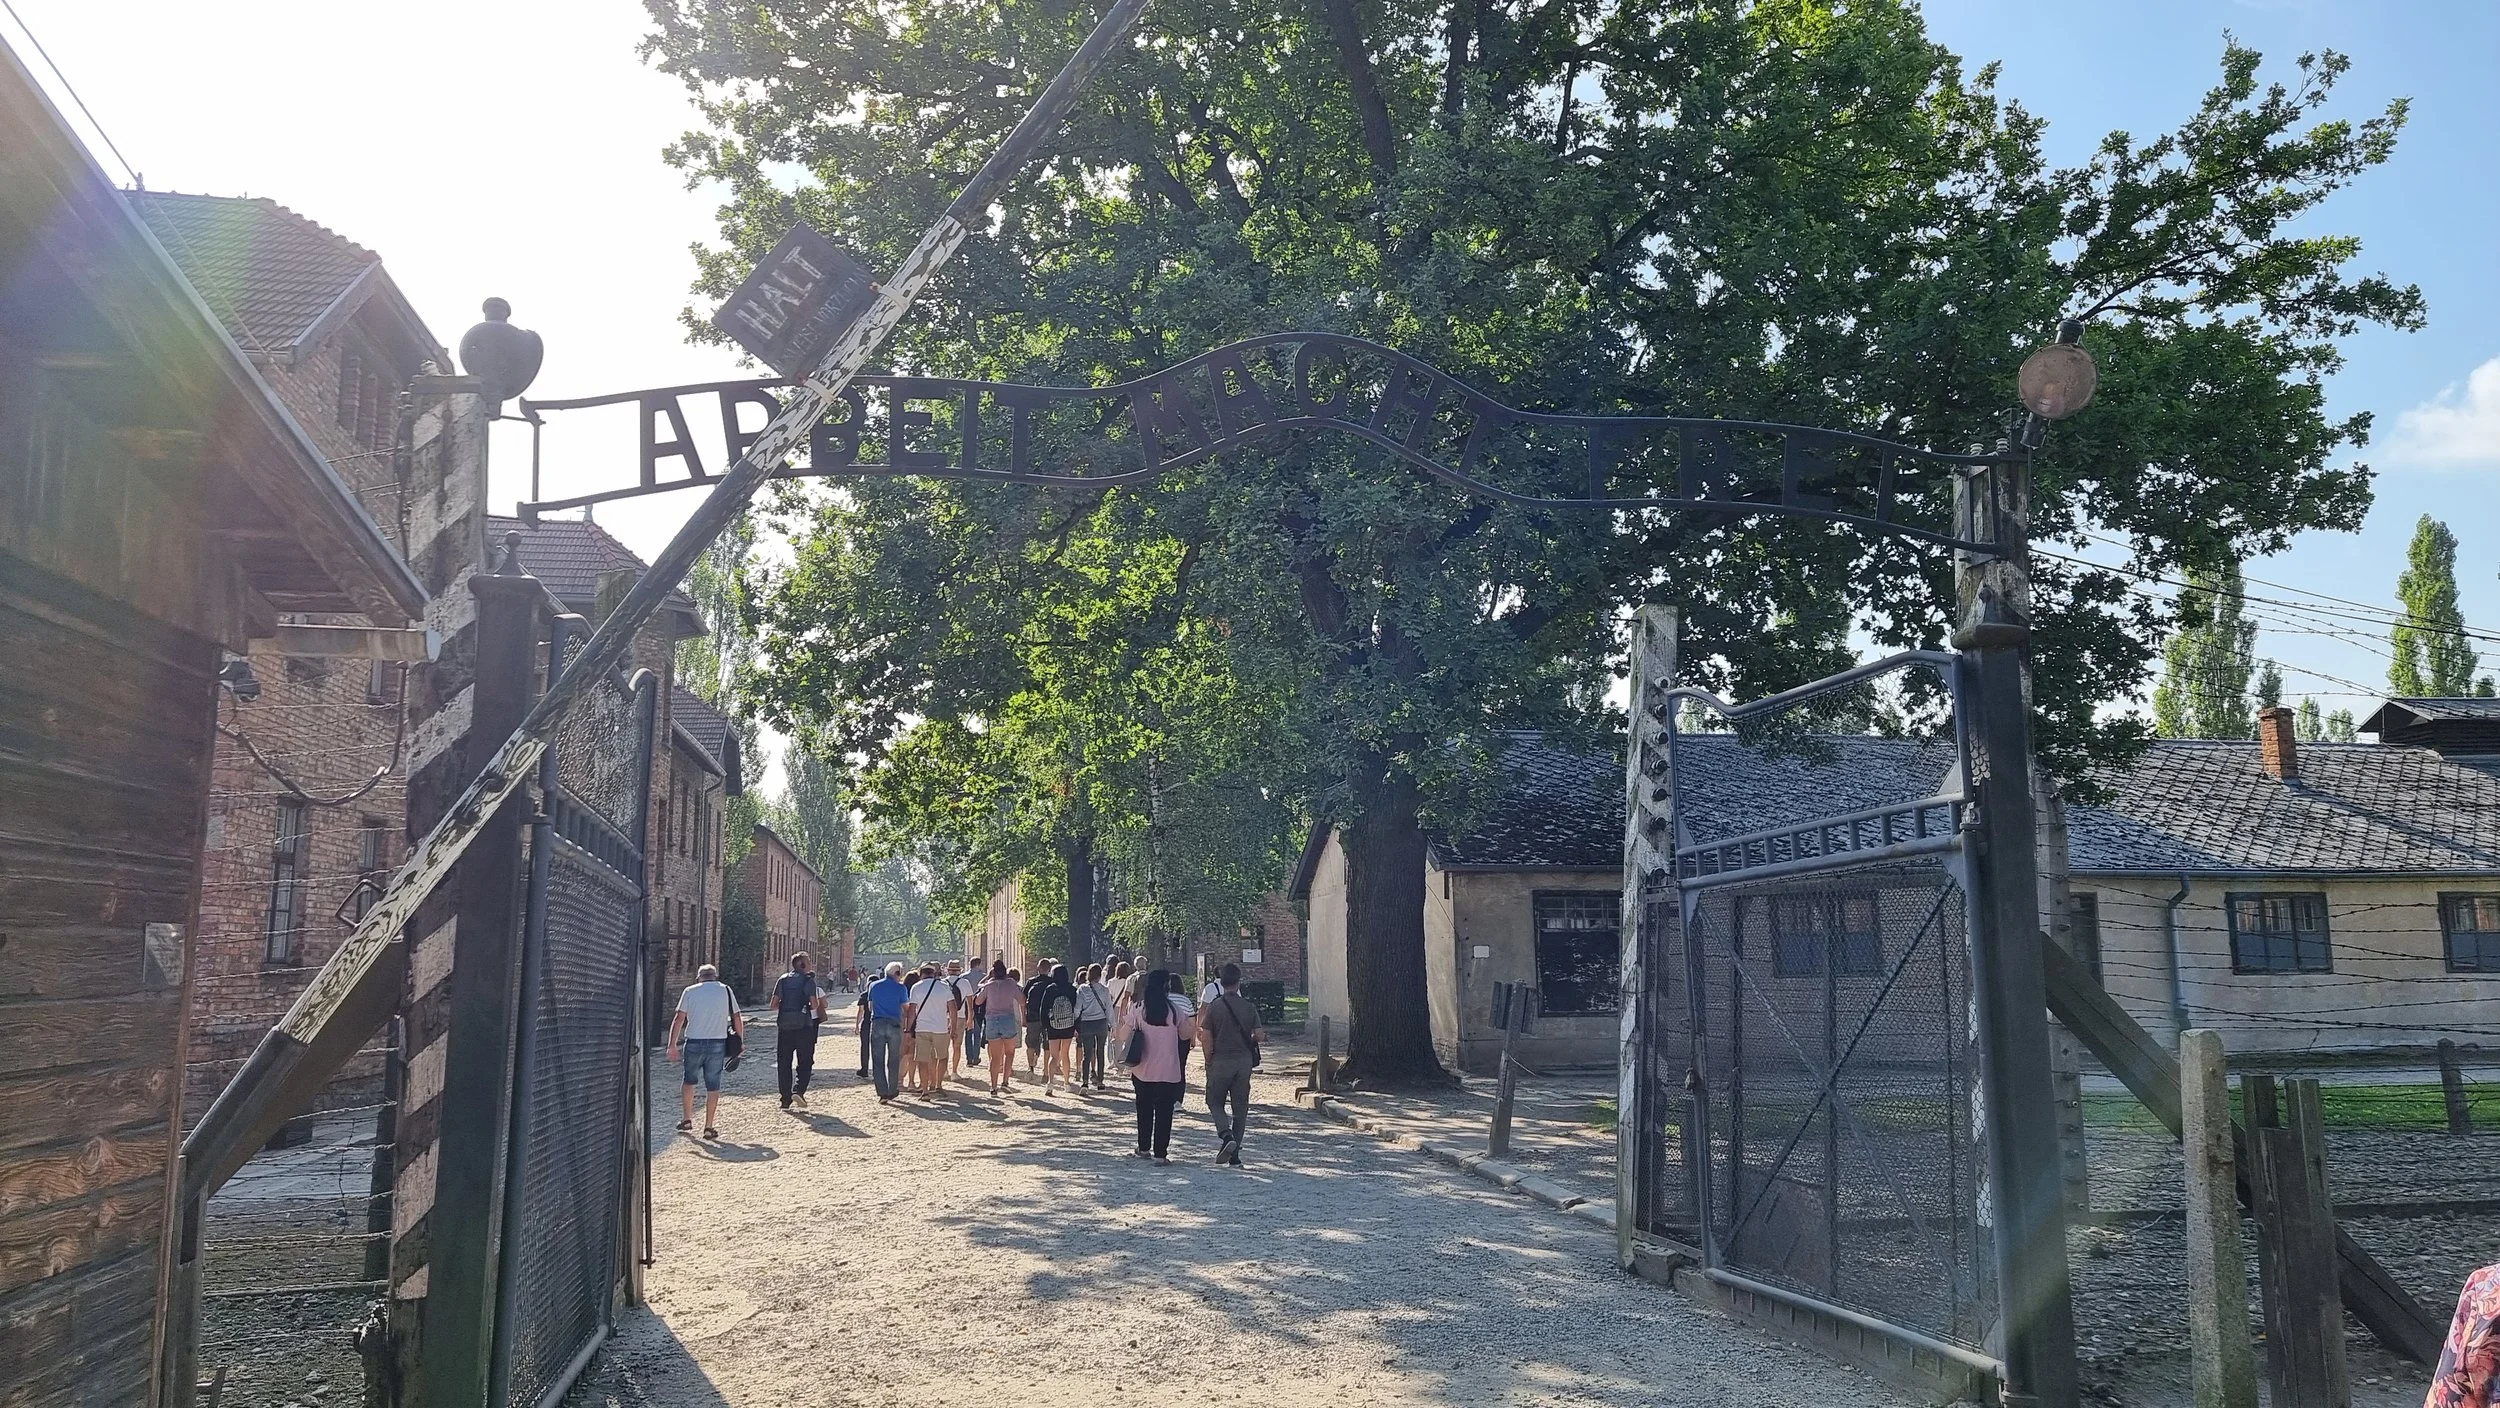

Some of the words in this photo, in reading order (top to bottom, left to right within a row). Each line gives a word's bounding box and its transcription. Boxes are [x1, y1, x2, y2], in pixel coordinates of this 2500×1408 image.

[736, 246, 824, 340] HALT
[640, 378, 1050, 488] ARBEIT
[1130, 338, 1512, 475] MACHT
